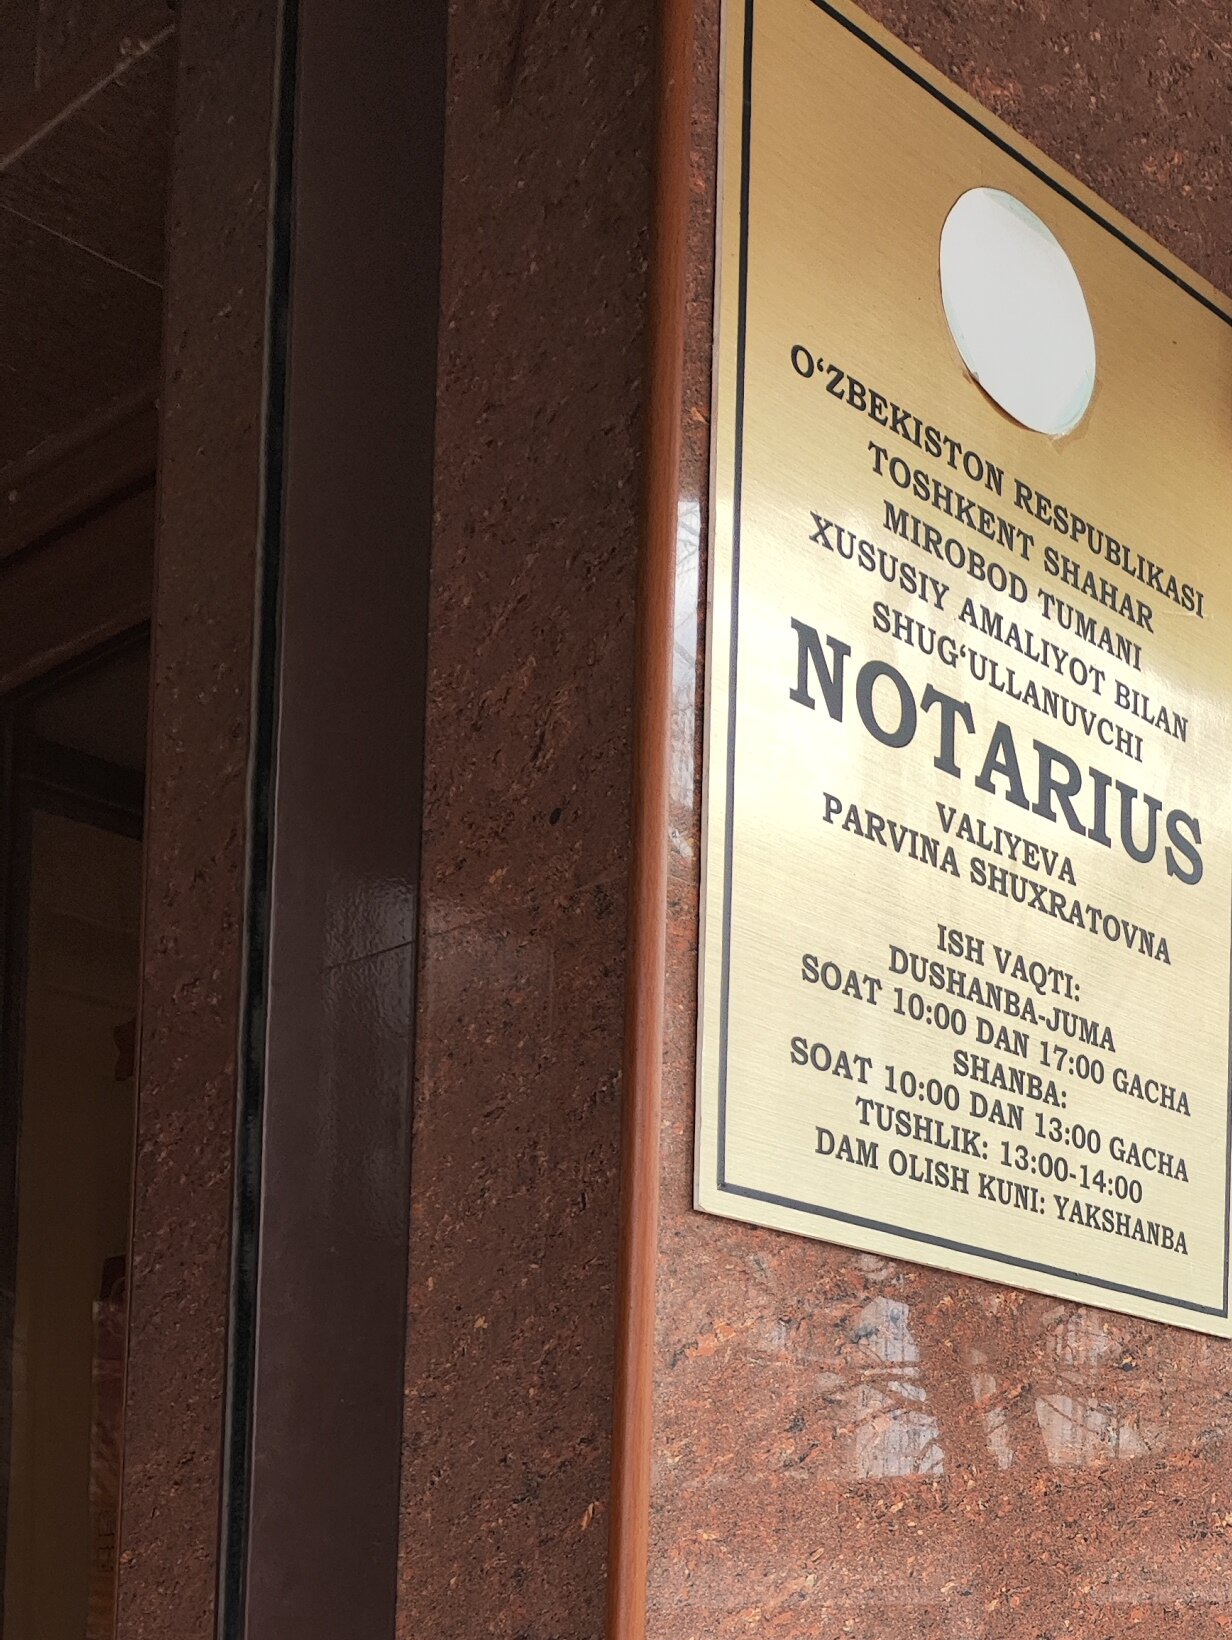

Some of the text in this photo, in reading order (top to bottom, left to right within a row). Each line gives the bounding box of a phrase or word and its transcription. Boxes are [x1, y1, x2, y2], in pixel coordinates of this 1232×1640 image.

[868, 441, 1154, 633] TOSHKENT SHAHAR
[883, 500, 1142, 671] MIROBOD TUMANI
[1014, 479, 1204, 619] RESPUBLIKASI
[809, 512, 1188, 743] XUSUSIY AMALIYOT BILAN
[790, 617, 1203, 885] NOTARIUS
[823, 792, 1172, 966] PARVINA SHUXRATOVNA
[936, 802, 1077, 887] VALIYEVA
[889, 945, 1116, 1053] DUSHANBA-JUMA
[937, 924, 1080, 1002] ISH VAQTI:
[801, 954, 1191, 1117] SOAT 10:00 DAN 17:00 GACHA
[953, 1050, 1067, 1109] SHANBA:
[790, 1037, 1189, 1183] SOAT 10:00 DAN 13:00 GACHA
[856, 1096, 1143, 1204] TUSHLIK: 13:00-14:00
[816, 1126, 1189, 1256] DAM OLISH KUNI: YAKSHANBA
